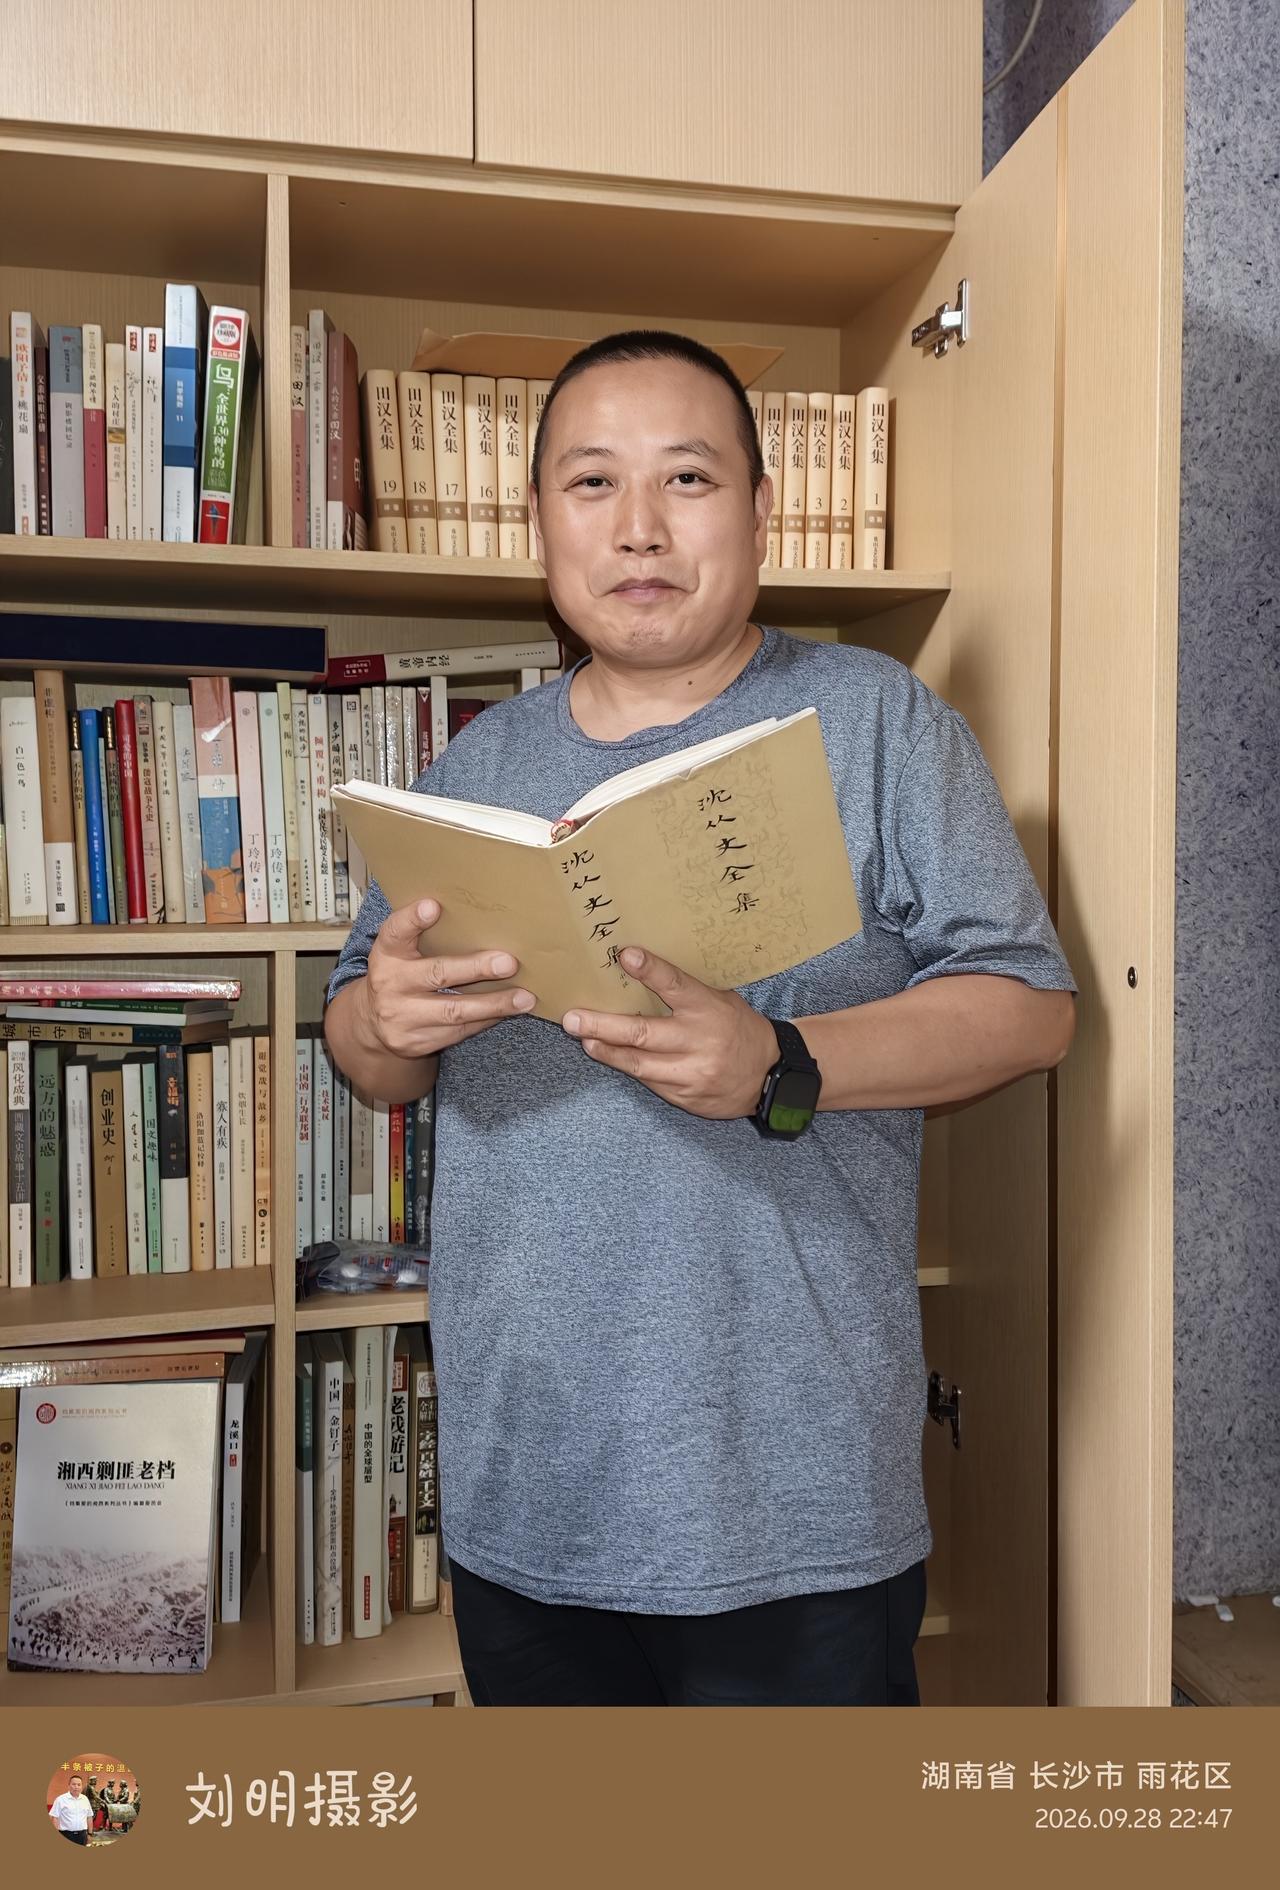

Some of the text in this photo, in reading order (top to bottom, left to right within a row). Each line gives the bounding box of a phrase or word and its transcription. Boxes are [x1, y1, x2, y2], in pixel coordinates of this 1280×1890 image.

[376, 386, 395, 450] 田汉全集
[408, 387, 425, 451] 田汉全集
[441, 390, 458, 453] 田汉全集
[477, 393, 492, 456] 田汉全集
[504, 394, 520, 457] 田汉全集
[767, 408, 781, 468] 田汉全集
[791, 408, 804, 469] 田汉全集
[813, 408, 827, 469] 田汉全集
[838, 410, 852, 470] 田汉全集
[871, 403, 885, 464] 田汉全集
[383, 480, 397, 493] 19
[413, 480, 427, 494] 18
[445, 483, 459, 496] 17
[480, 485, 493, 498] 16
[506, 487, 520, 500] 15
[792, 497, 800, 509] 4
[815, 497, 822, 510] 3
[840, 498, 848, 511] 2
[874, 493, 879, 505] 1
[399, 654, 450, 668] 黄帝内经
[248, 832, 261, 873] 丁玲传
[270, 832, 284, 873] 丁玲传
[697, 789, 760, 915] 沈从文全集
[3, 1023, 92, 1041] 城市守望
[12, 1062, 25, 1106] 风化成典
[39, 1074, 56, 1157] 远方的魅惑
[101, 1088, 116, 1147] 创业史
[216, 1100, 228, 1149] 寡人有疾
[146, 1119, 158, 1162] 国文趣味
[364, 1423, 373, 1484] 中国的全球层型
[389, 1395, 406, 1474] 老残游记
[57, 1460, 176, 1480] 湘西剿匪老档
[65, 1482, 165, 1490] XIANG XI JIAO FEI LAO DANG
